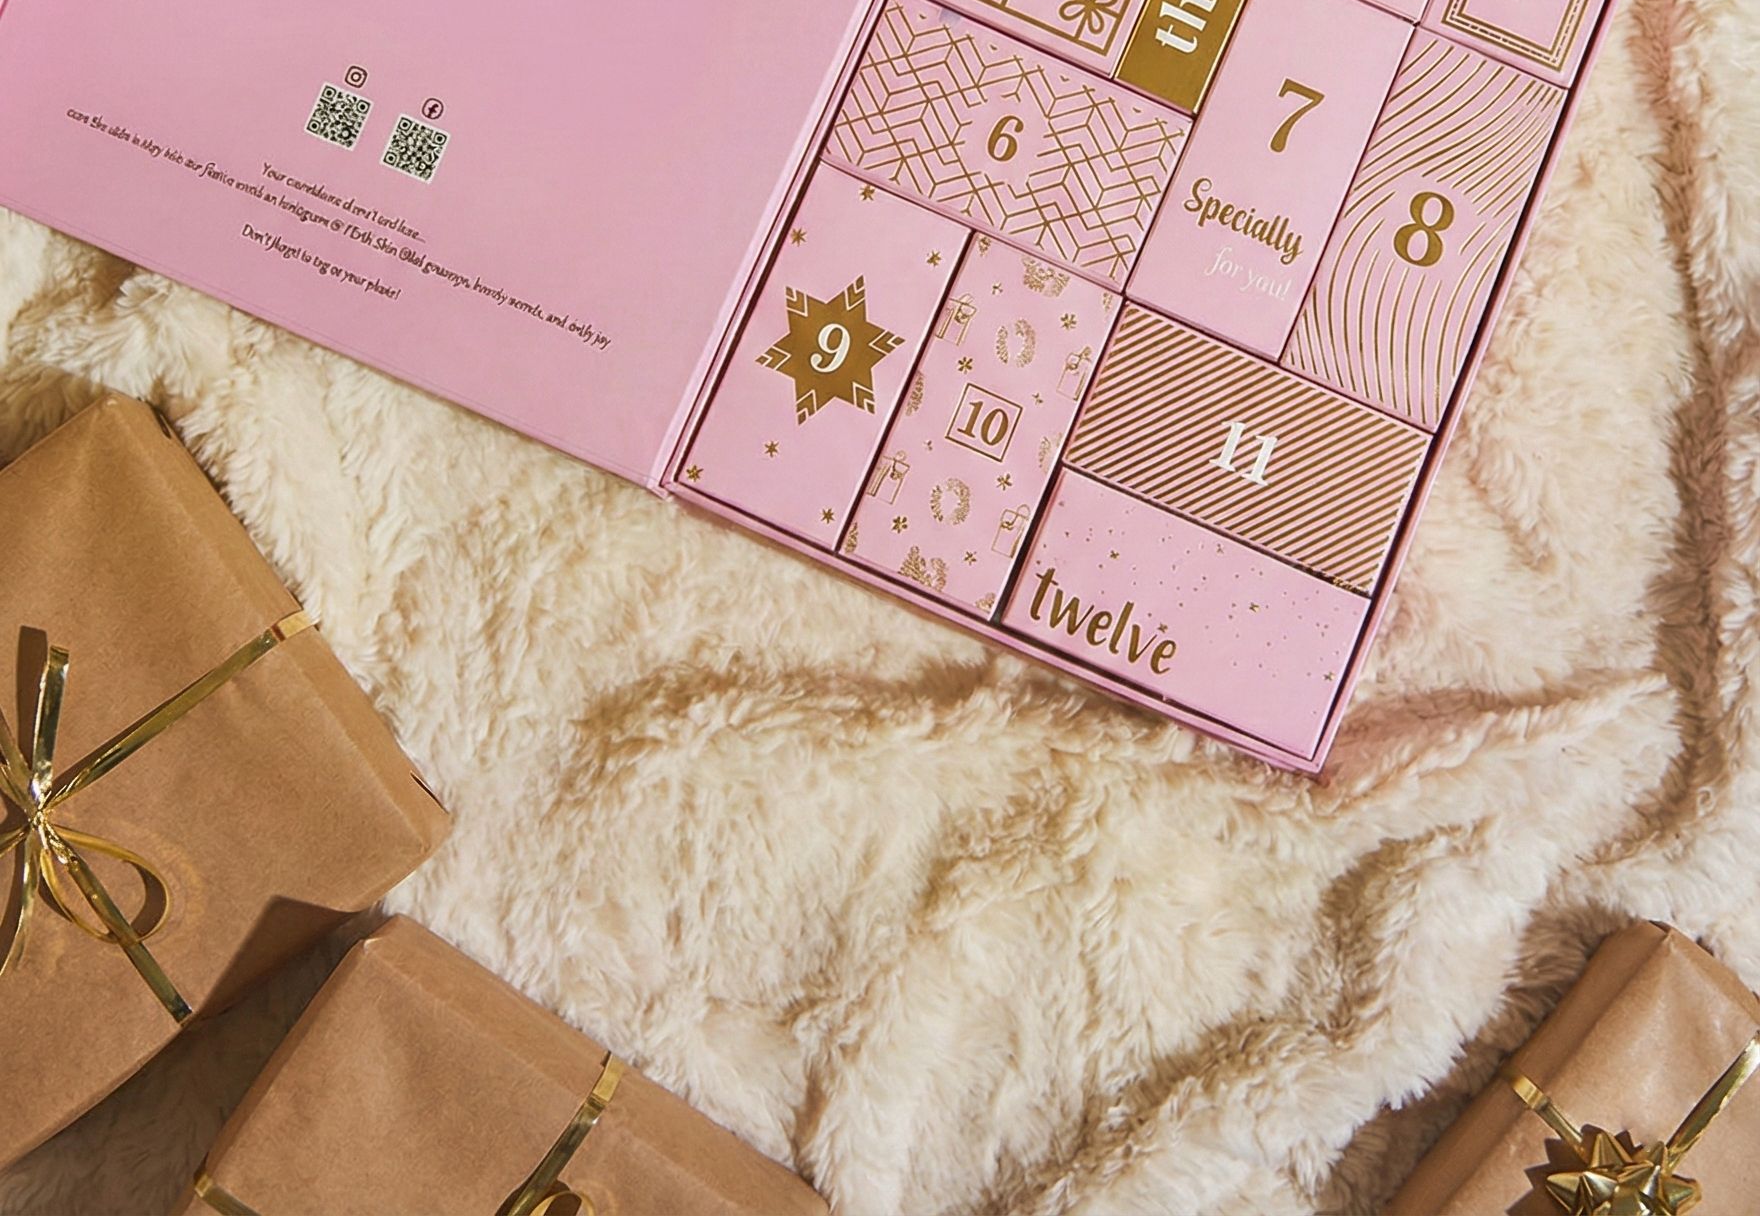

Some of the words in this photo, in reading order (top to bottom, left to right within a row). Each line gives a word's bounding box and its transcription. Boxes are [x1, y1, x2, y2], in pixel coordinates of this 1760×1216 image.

[986, 114, 1024, 163] 6
[1267, 77, 1325, 154] 7
[1183, 177, 1303, 266] Specially
[1393, 191, 1455, 267] 8
[1204, 246, 1244, 276] for
[1240, 267, 1292, 301] you!
[808, 322, 852, 375] 9
[956, 397, 1010, 448] 10
[1207, 419, 1279, 486] 11
[1026, 567, 1179, 676] twelve
